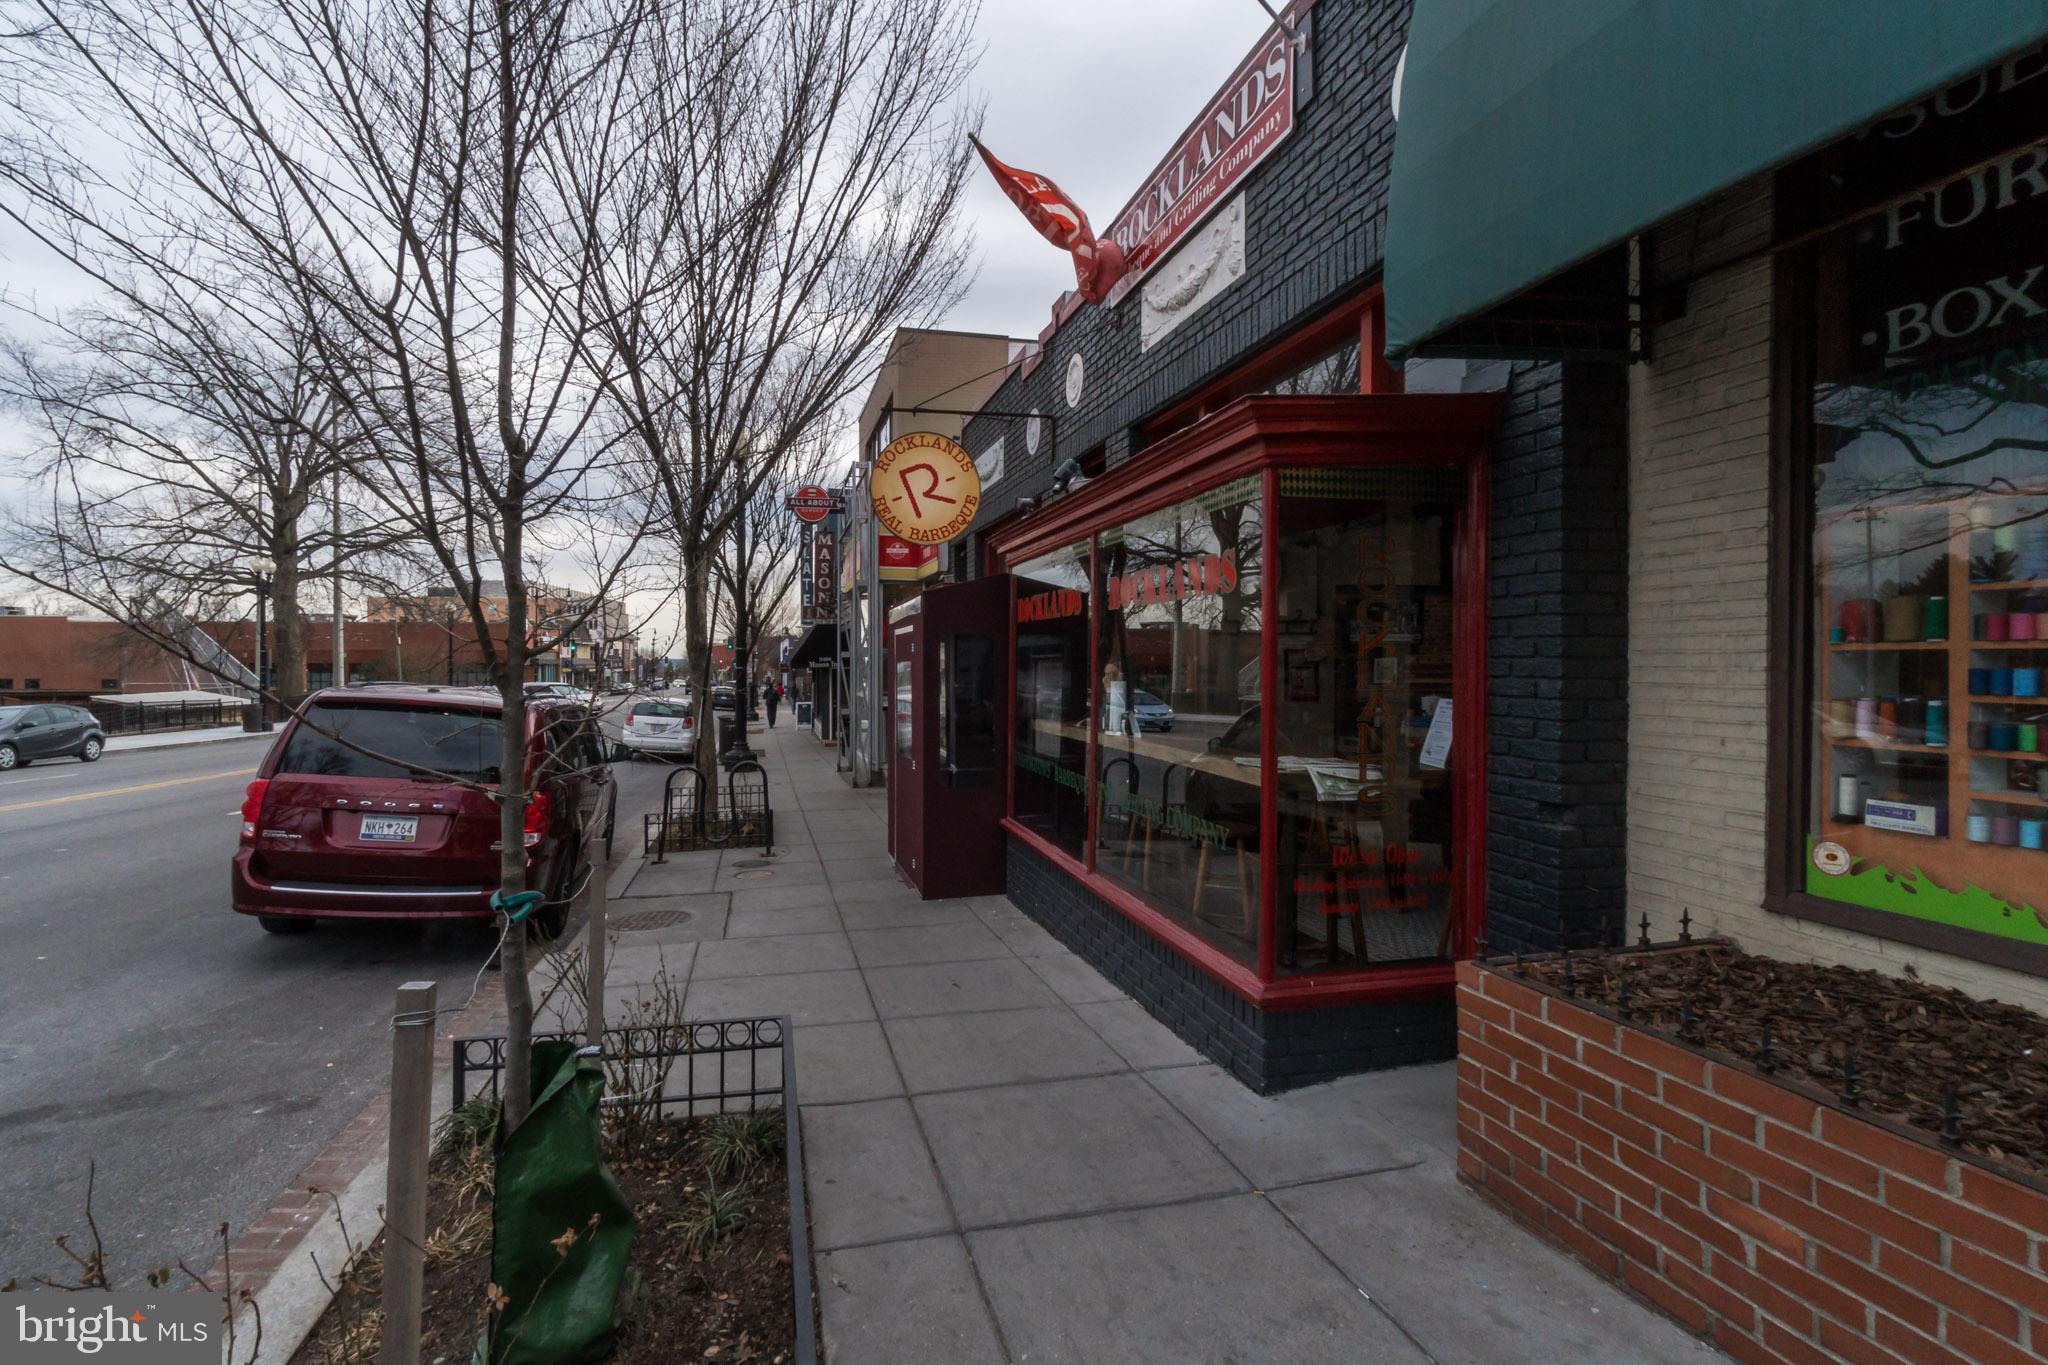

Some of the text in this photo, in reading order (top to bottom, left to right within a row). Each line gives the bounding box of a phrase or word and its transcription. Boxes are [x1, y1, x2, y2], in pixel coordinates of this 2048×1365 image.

[1117, 39, 1286, 257] ROCKLANDS
[1154, 217, 1172, 249] and
[1174, 175, 1217, 226] Grilling
[1220, 105, 1284, 180] Company
[875, 434, 975, 474] ROCKLANDS
[874, 495, 903, 534] REAL
[909, 495, 978, 541] BARBEQUE
[802, 530, 811, 606] SLATE
[818, 533, 833, 604] MASON
[365, 820, 414, 835] NKH 264
